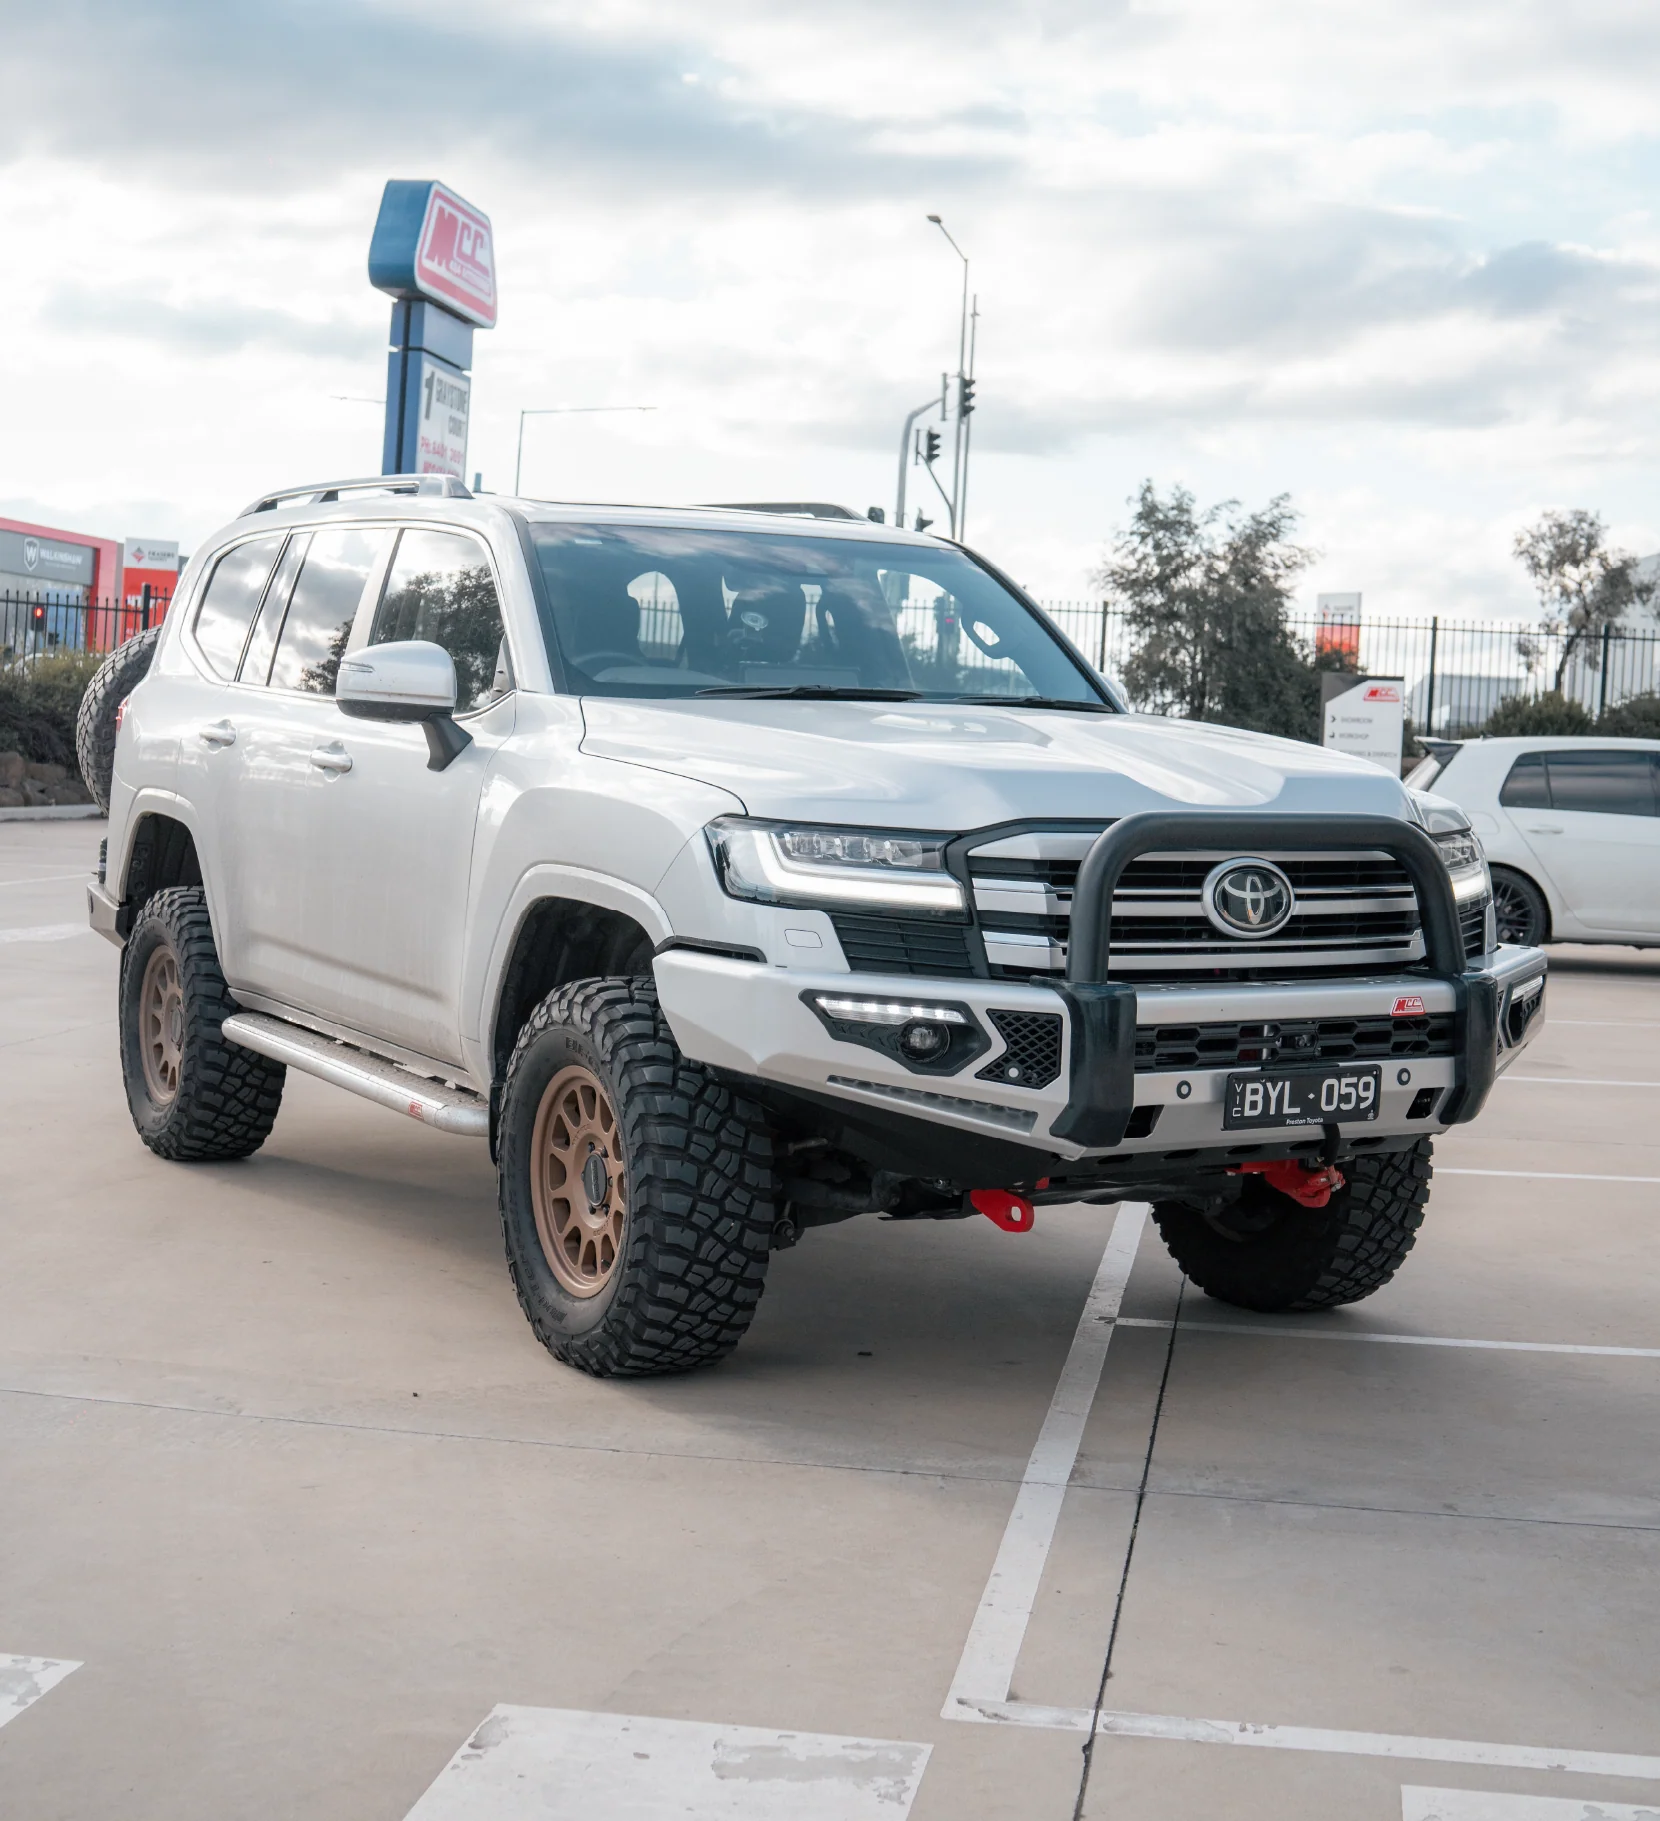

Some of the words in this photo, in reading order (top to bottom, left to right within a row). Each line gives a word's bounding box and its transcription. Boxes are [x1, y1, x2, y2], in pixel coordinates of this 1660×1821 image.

[425, 205, 490, 278] MCC
[425, 370, 435, 421] 1
[1243, 1081, 1301, 1117] BYL
[1320, 1076, 1375, 1112] 059
[1286, 1118, 1306, 1126] Preston
[1306, 1117, 1324, 1126] Toyota
